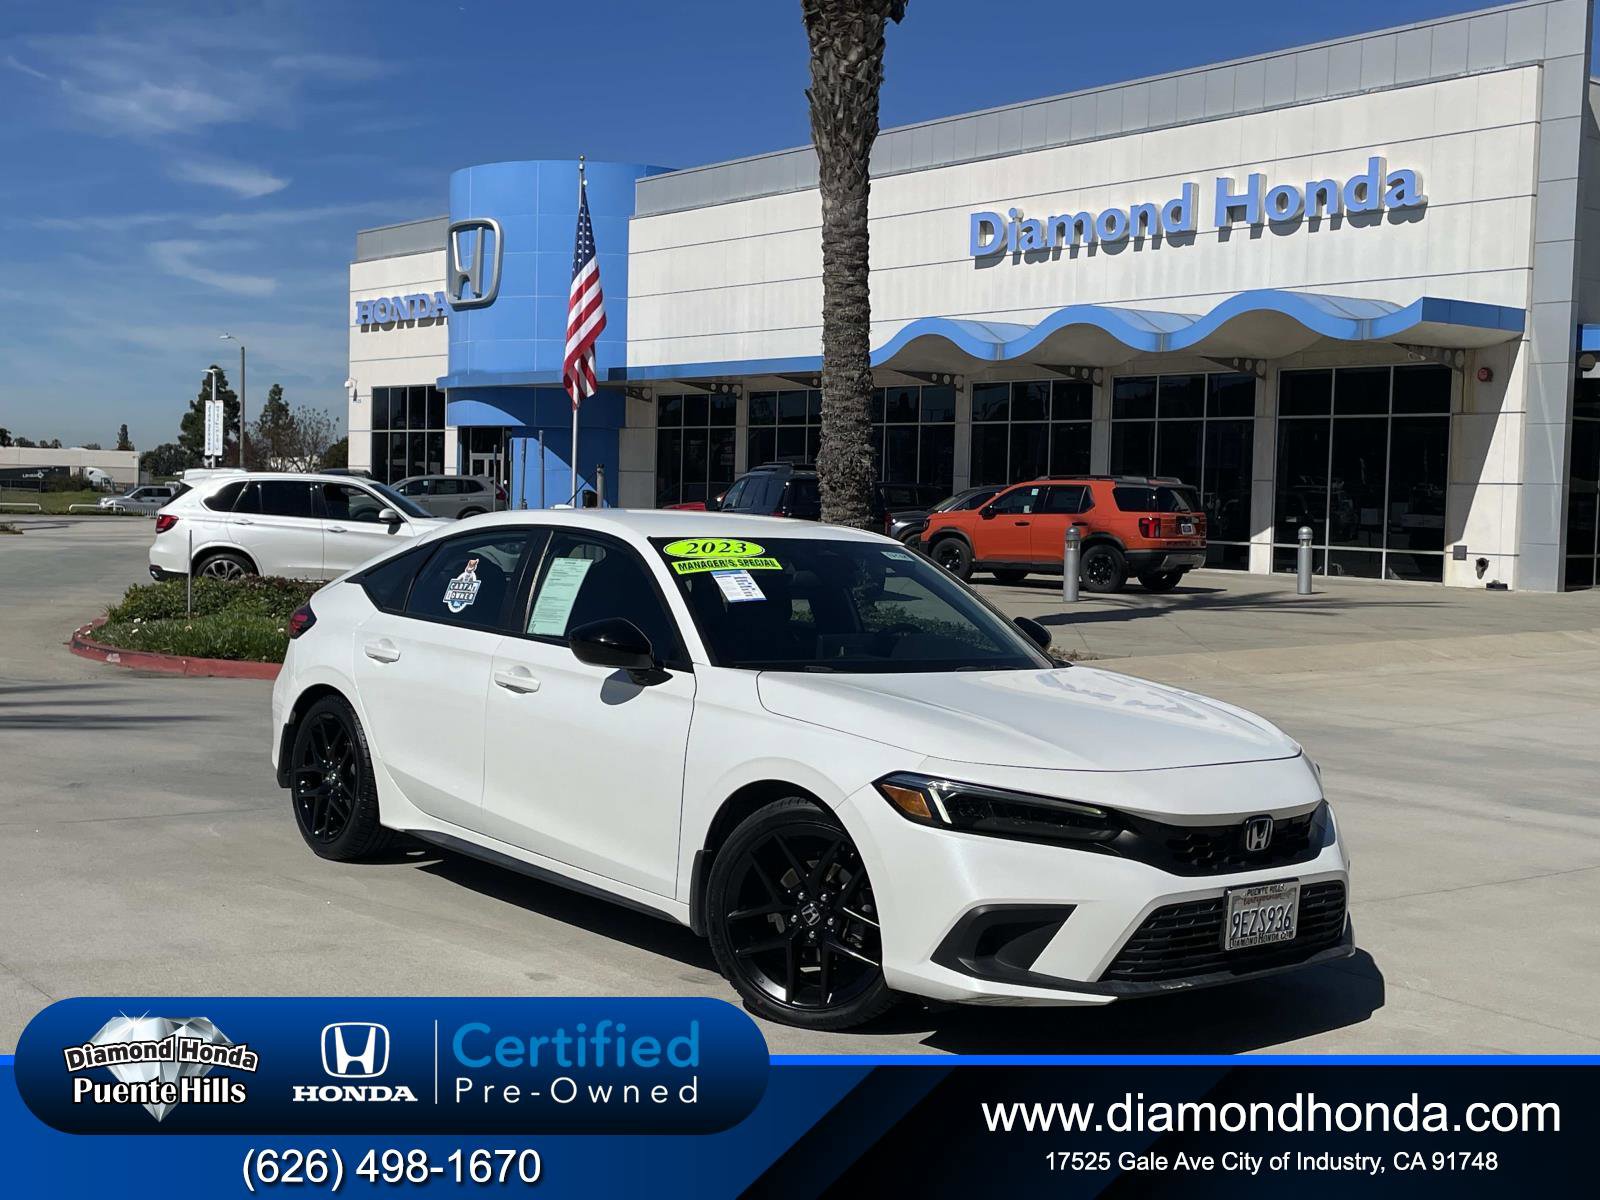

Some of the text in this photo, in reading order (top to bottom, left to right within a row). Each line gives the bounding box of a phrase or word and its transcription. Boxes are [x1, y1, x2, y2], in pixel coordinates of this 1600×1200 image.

[969, 156, 1425, 258] Diamond Honda
[355, 291, 448, 324] HONDA
[686, 542, 747, 554] 2023
[677, 559, 777, 571] MANAGER'S SPECIAL
[1247, 886, 1269, 896] PUENTE
[1231, 902, 1293, 937] 9EZS936
